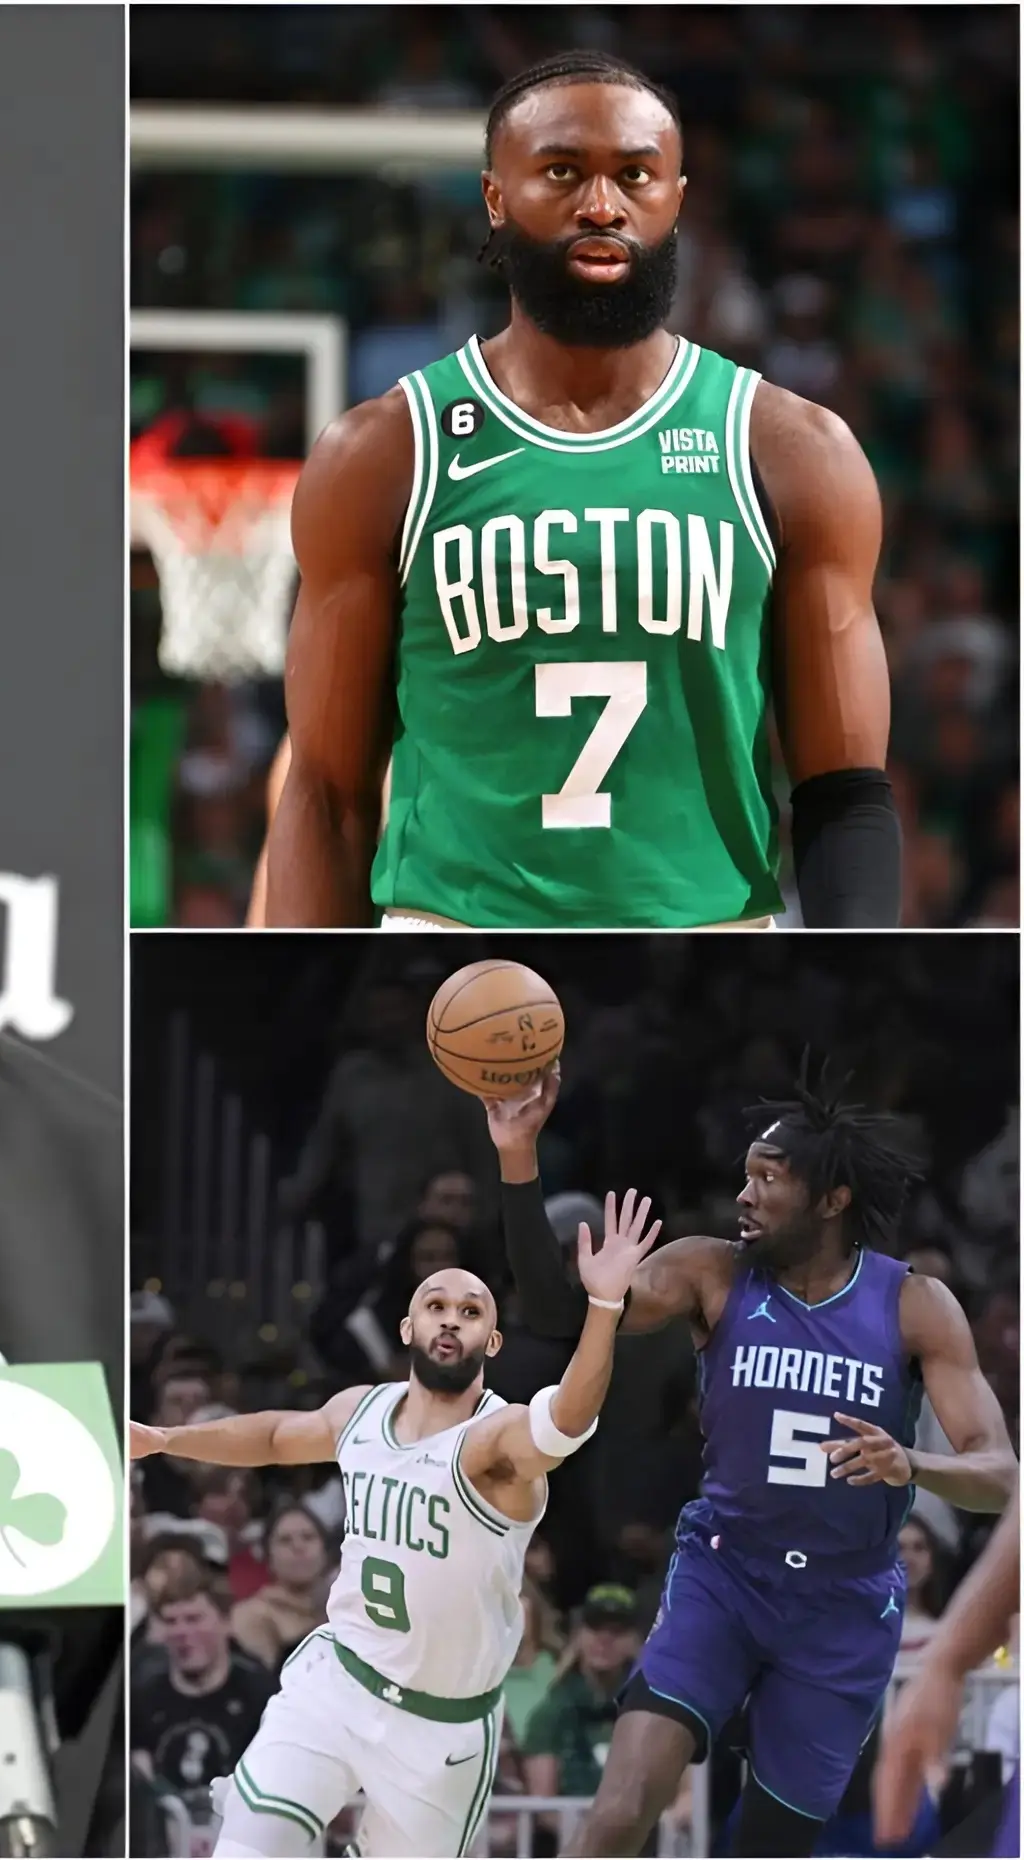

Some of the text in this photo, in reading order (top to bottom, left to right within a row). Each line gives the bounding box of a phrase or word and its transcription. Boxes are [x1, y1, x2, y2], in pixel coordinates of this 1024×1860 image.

[450, 402, 476, 435] 6
[658, 427, 720, 455] VISTA
[661, 454, 721, 475] PRINT
[432, 507, 735, 656] BOSTON
[534, 660, 648, 829] 7
[729, 1345, 885, 1408] HORNETS
[766, 1408, 831, 1488] 5
[360, 1555, 412, 1634] 9
